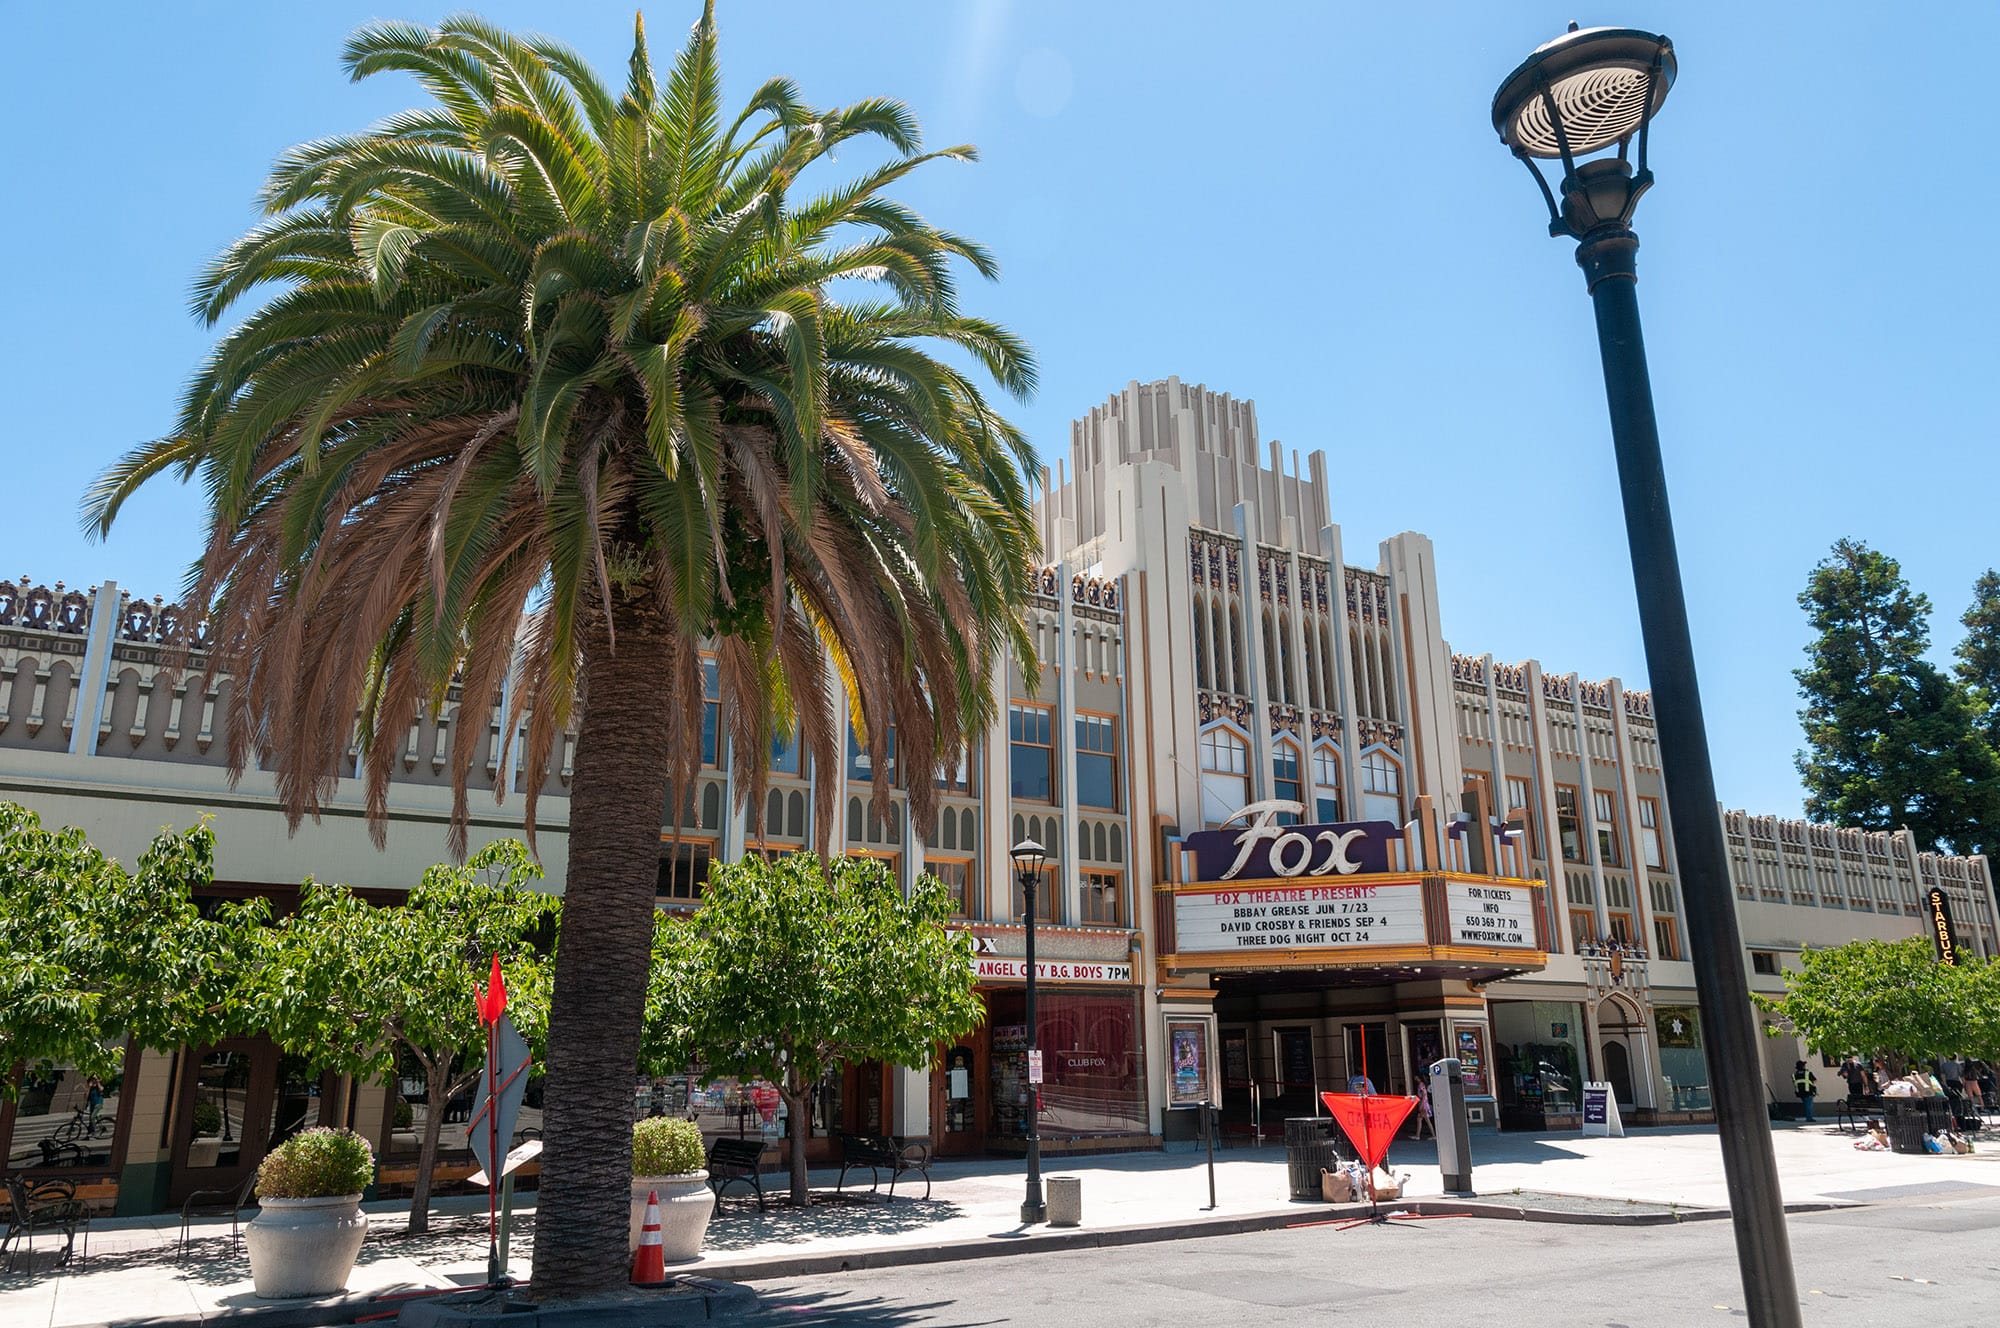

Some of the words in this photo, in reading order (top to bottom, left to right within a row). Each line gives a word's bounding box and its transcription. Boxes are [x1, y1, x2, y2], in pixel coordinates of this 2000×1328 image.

[1214, 892, 1240, 905] FOX
[1247, 889, 1306, 903] THEATRE
[1312, 886, 1377, 900] PRESENTS
[1468, 887, 1482, 898] FOR
[1483, 889, 1512, 900] TICKETS
[1234, 907, 1266, 918] BBBAY
[1271, 905, 1310, 916] GREASE
[1315, 904, 1335, 914] JUN
[1341, 903, 1368, 913] 7/23
[1482, 903, 1499, 913] INFO
[1220, 922, 1251, 932] DAVID
[1255, 920, 1295, 931] CROSBY
[1298, 920, 1305, 929] &
[1309, 918, 1351, 929] FRIENDS
[1355, 917, 1375, 927] SEP
[1380, 916, 1387, 926] 4
[1465, 915, 1480, 926] 650
[1481, 917, 1495, 928] 369
[1497, 918, 1506, 928] 77
[1508, 919, 1518, 929] 70
[1237, 935, 1266, 946] THREE
[1270, 934, 1291, 945] DOG
[1295, 933, 1326, 944] NIGHT
[1331, 932, 1351, 943] OCT
[1355, 932, 1369, 941] 24
[978, 962, 1016, 976] ANGEL
[1020, 963, 1046, 977] CTY
[1051, 965, 1070, 978] B.G.
[1074, 965, 1102, 978] BOYS
[1107, 967, 1130, 979] 7PM
[1067, 1058, 1089, 1067] CLUB
[1090, 1057, 1106, 1067] FOX
